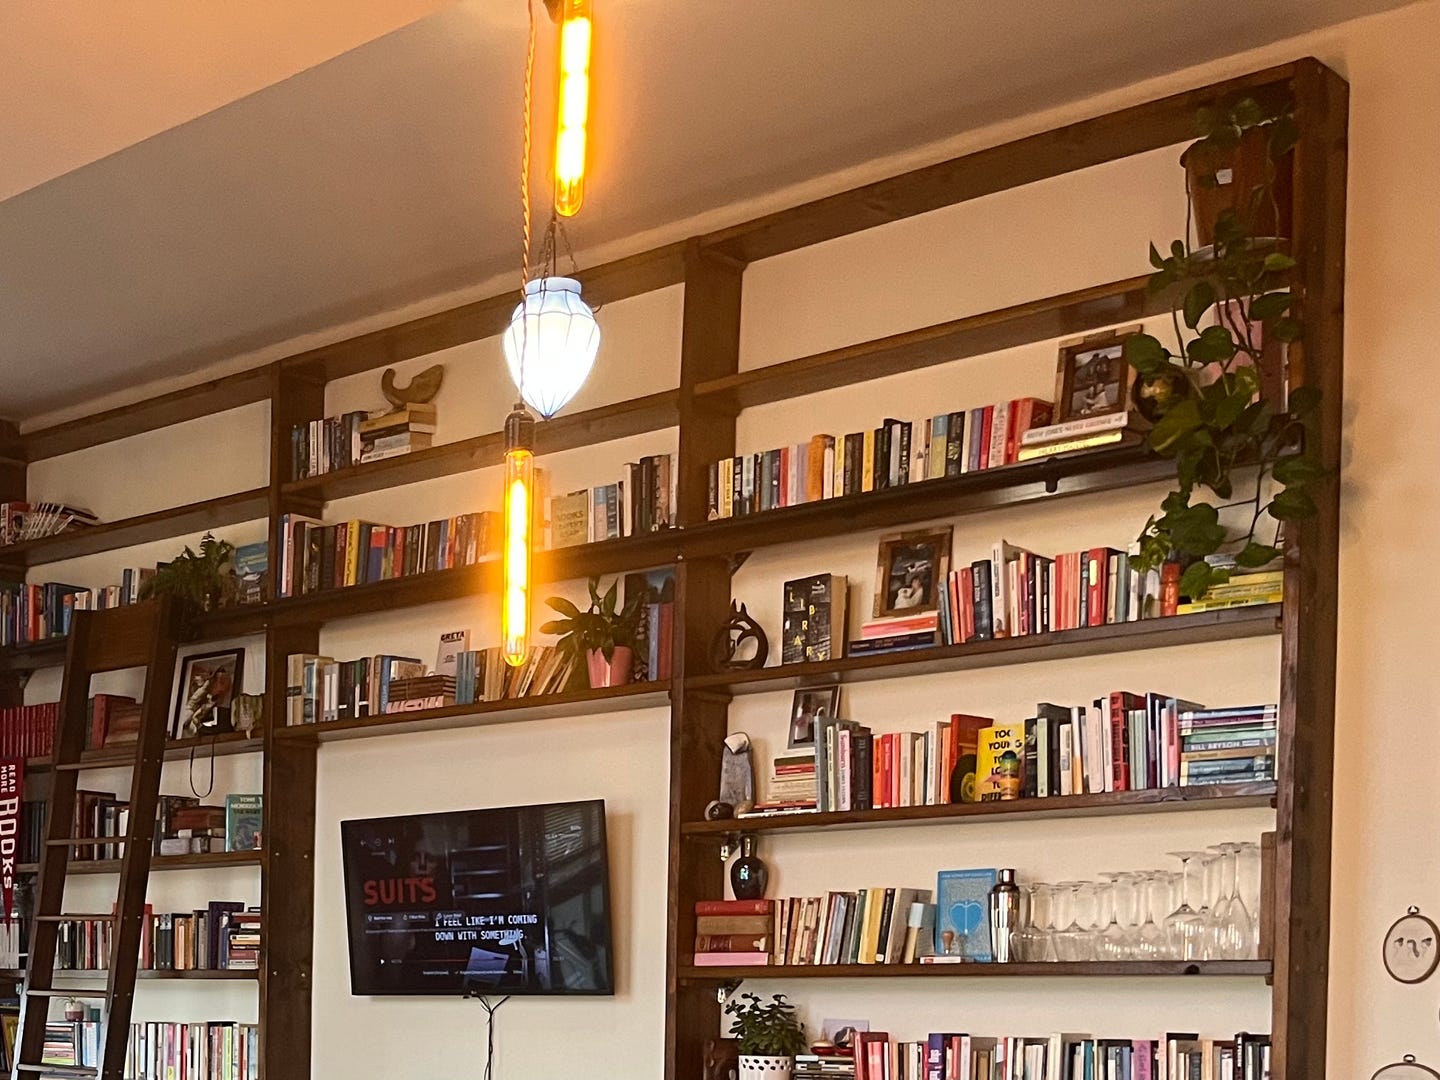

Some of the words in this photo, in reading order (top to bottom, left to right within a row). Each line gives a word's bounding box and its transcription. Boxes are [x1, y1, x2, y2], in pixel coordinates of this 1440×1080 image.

[0, 766, 8, 793] MORE
[8, 764, 16, 792] READ
[363, 878, 436, 905] SUITS
[443, 918, 463, 927] FEEL
[466, 916, 485, 926] LIKE
[489, 915, 505, 925] I'M
[508, 914, 538, 925] COMING
[435, 931, 454, 941] DOWN
[458, 931, 477, 940] WITH
